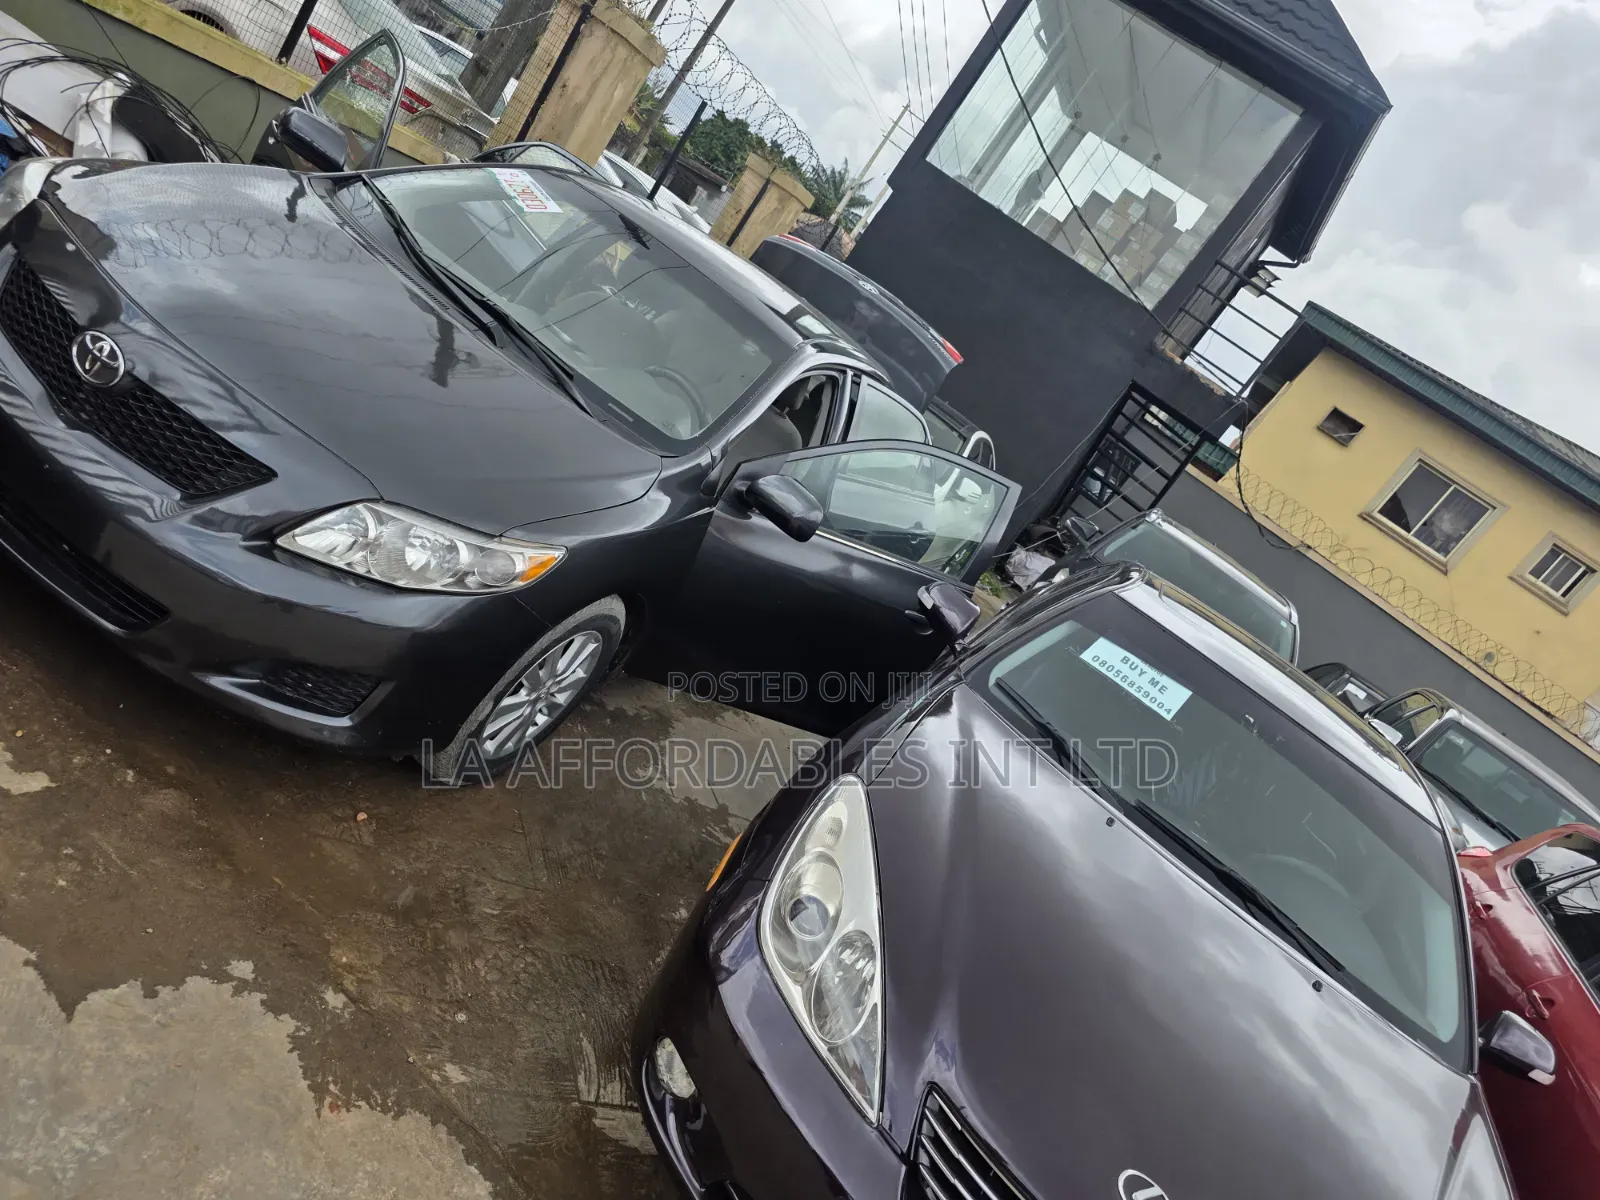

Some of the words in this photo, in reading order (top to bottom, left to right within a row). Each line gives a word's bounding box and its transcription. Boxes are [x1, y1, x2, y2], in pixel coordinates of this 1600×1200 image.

[1091, 655, 1173, 715] 08056859004
[1119, 655, 1148, 678] BUY
[1147, 677, 1169, 695] ME
